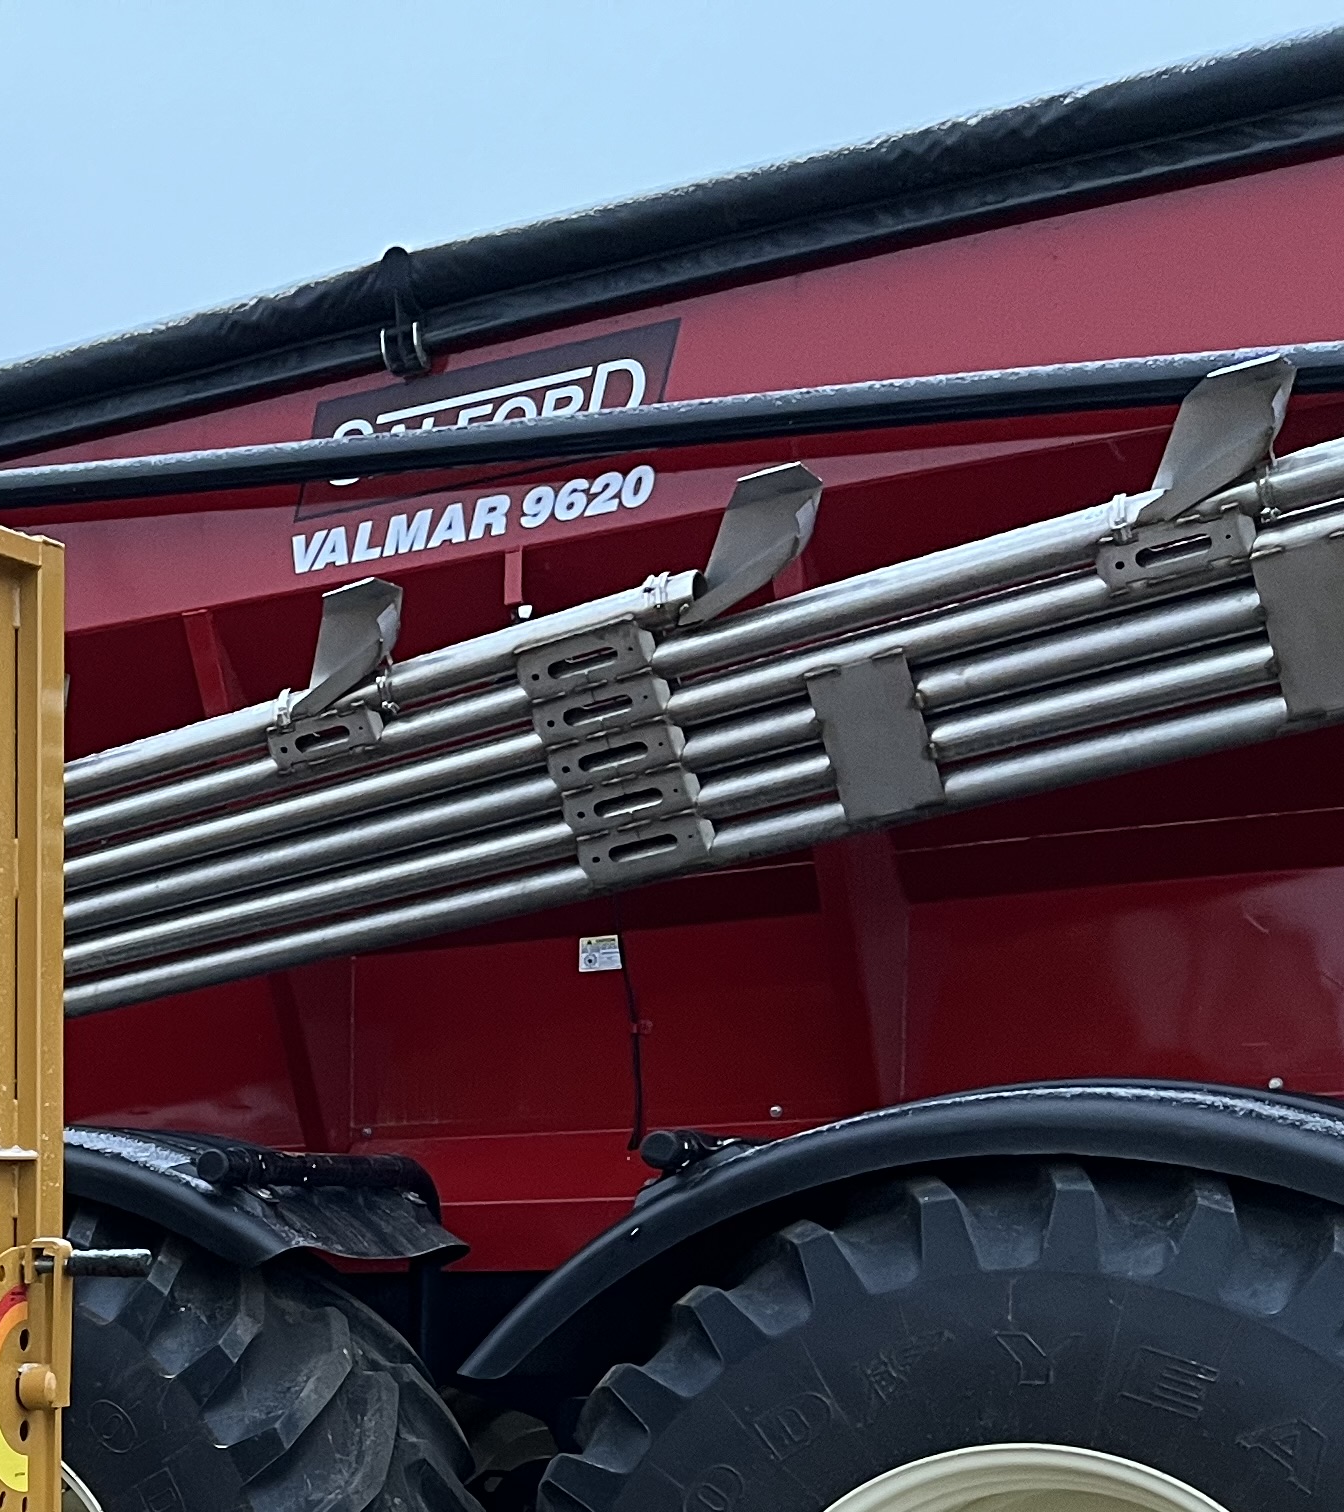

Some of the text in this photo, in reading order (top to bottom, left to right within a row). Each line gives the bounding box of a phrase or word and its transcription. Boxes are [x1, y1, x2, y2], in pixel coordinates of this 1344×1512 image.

[328, 358, 647, 487] FORD
[291, 464, 656, 575] VALMAR 9620
